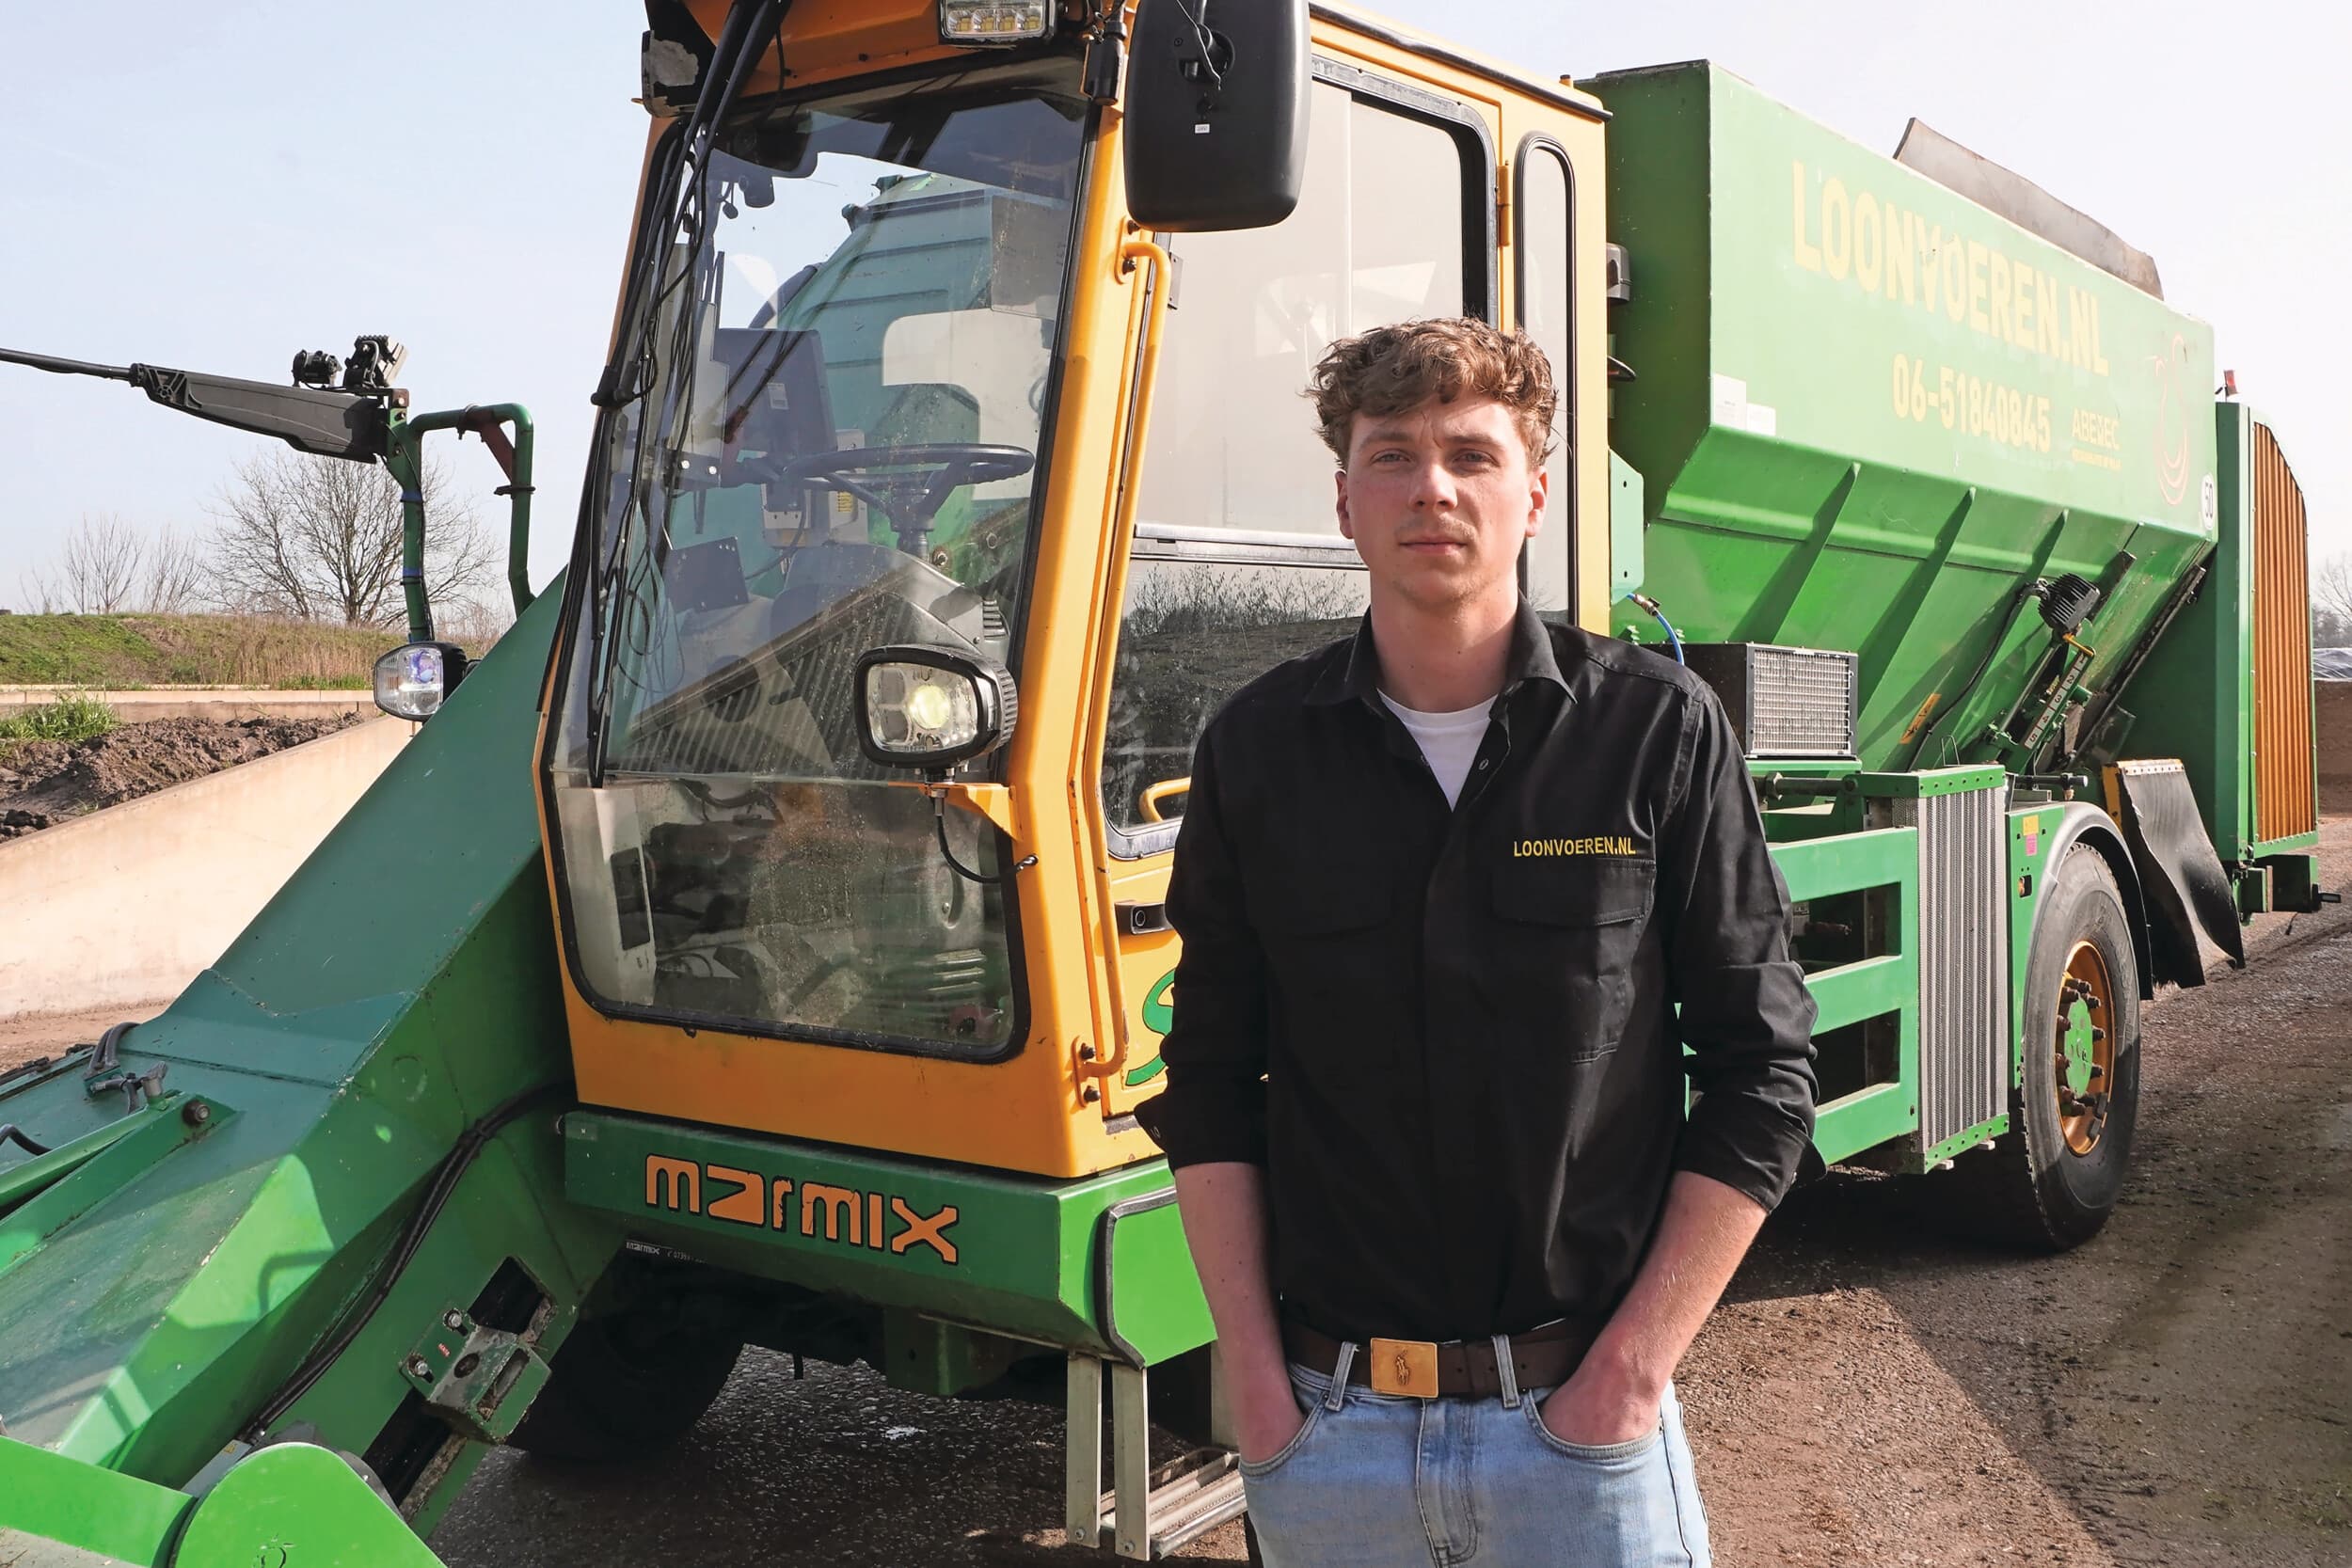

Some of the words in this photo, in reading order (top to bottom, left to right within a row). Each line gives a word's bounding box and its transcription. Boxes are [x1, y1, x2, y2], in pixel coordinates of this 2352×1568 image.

[1792, 160, 2109, 377] LOONVOEREN.NL
[1892, 353, 2052, 453] 06-51840845
[1514, 836, 1636, 857] LOONVOEREN.NL
